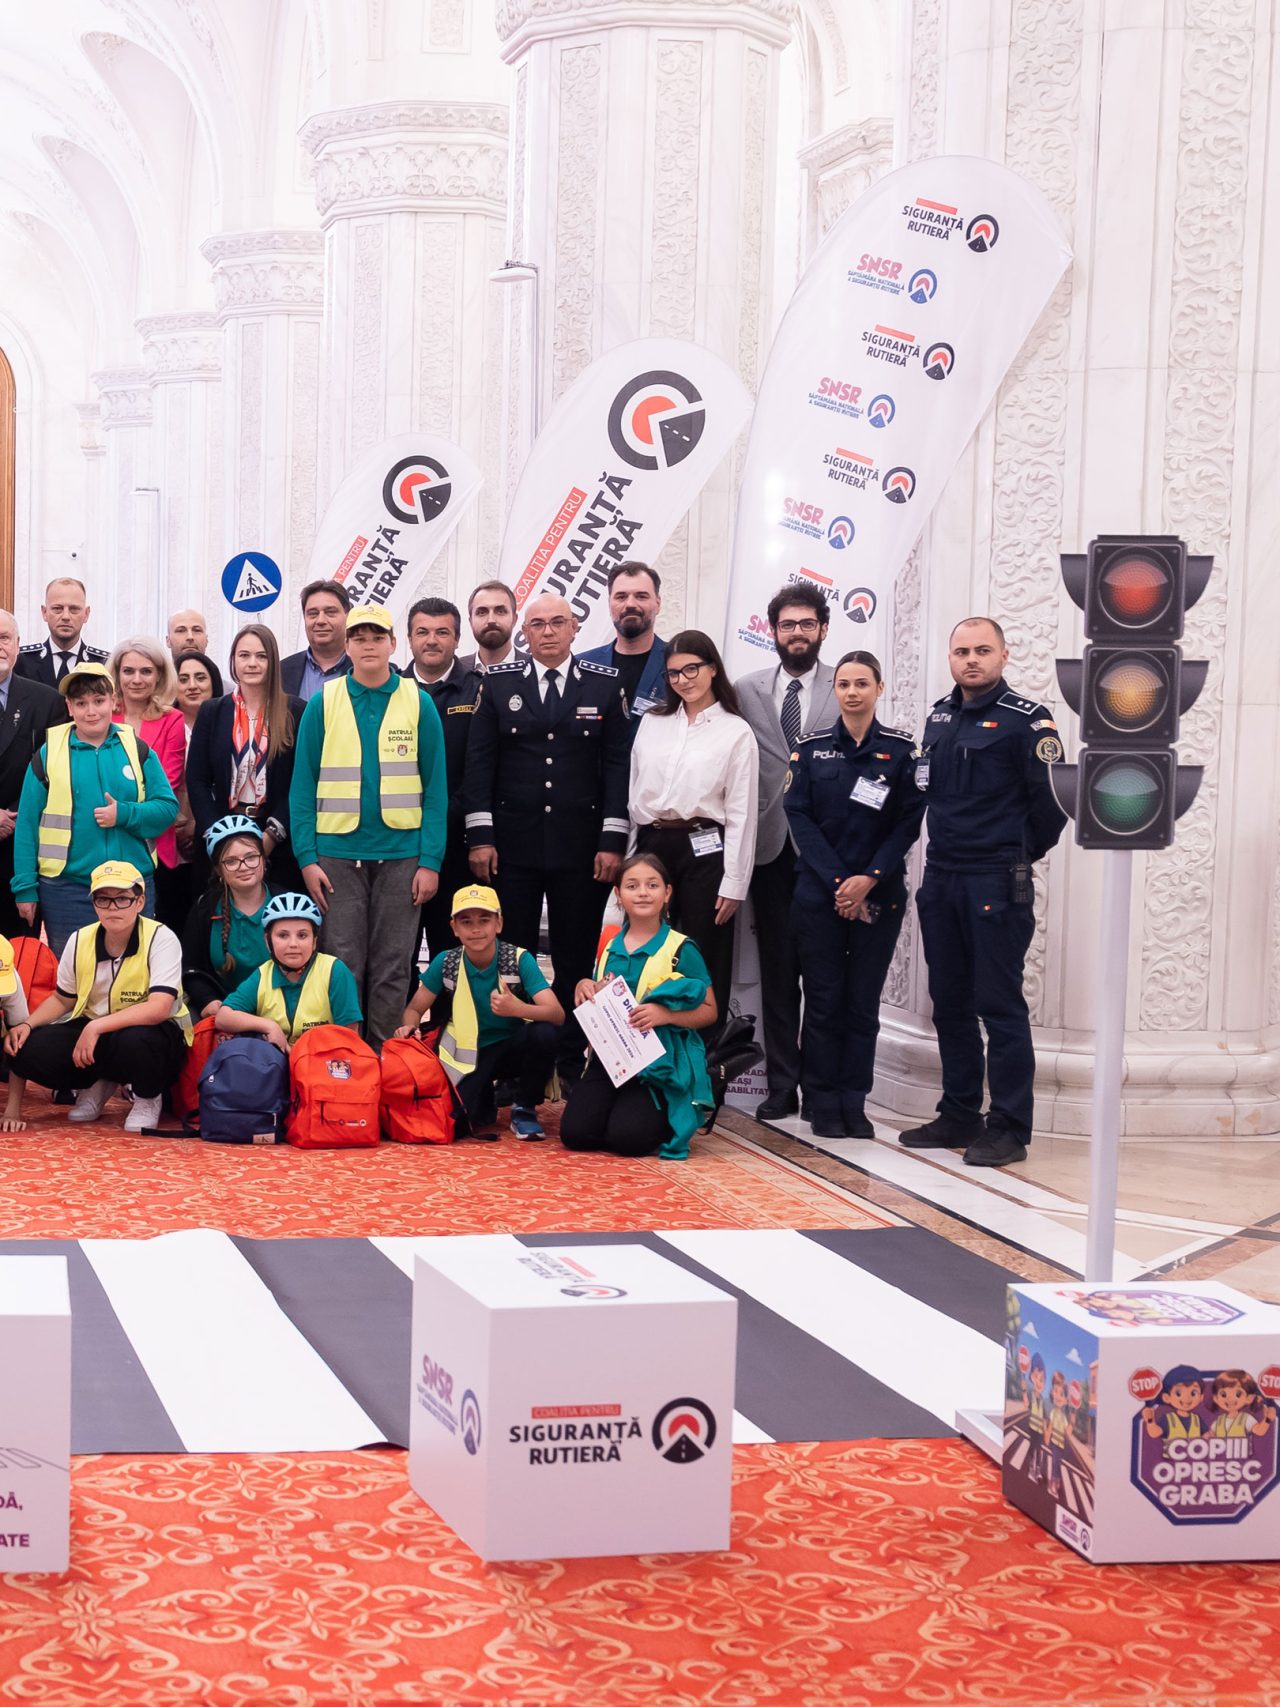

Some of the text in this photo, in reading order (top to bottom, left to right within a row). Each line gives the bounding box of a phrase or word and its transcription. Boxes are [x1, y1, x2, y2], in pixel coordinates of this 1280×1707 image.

[857, 254, 903, 281] SNSR
[817, 376, 863, 405] SNSR
[545, 492, 582, 546] PENTRU
[783, 497, 824, 526] SNSR
[339, 539, 365, 573] PENTRU
[570, 514, 643, 643] UTIERĂ
[747, 614, 775, 638] SN
[1132, 1377, 1159, 1392] STOP
[1261, 1374, 1280, 1387] STO
[509, 1416, 642, 1443] SIGURANȚĂ
[529, 1440, 622, 1465] RUTIERĂ
[1168, 1438, 1248, 1460] COPIII
[1152, 1460, 1262, 1483] OPRESC
[1159, 1483, 1254, 1506] GRABA
